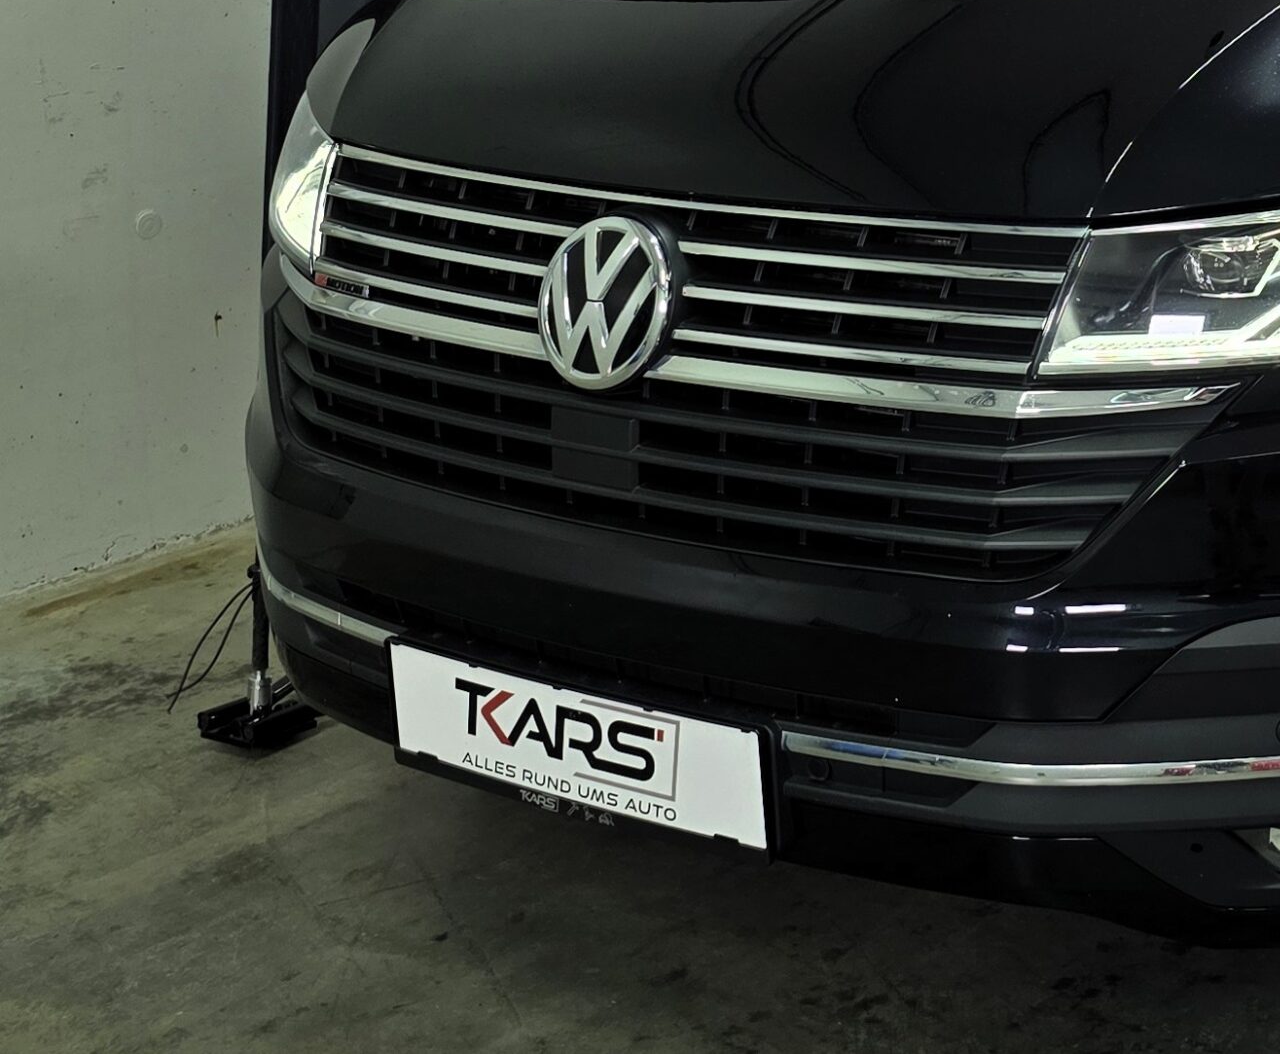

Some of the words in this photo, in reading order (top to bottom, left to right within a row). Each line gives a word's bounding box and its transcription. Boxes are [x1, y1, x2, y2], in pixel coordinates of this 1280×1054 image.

[461, 751, 516, 778] ALLES
[521, 769, 572, 795] RUND
[577, 783, 619, 808] UMS
[624, 798, 678, 822] AUTO
